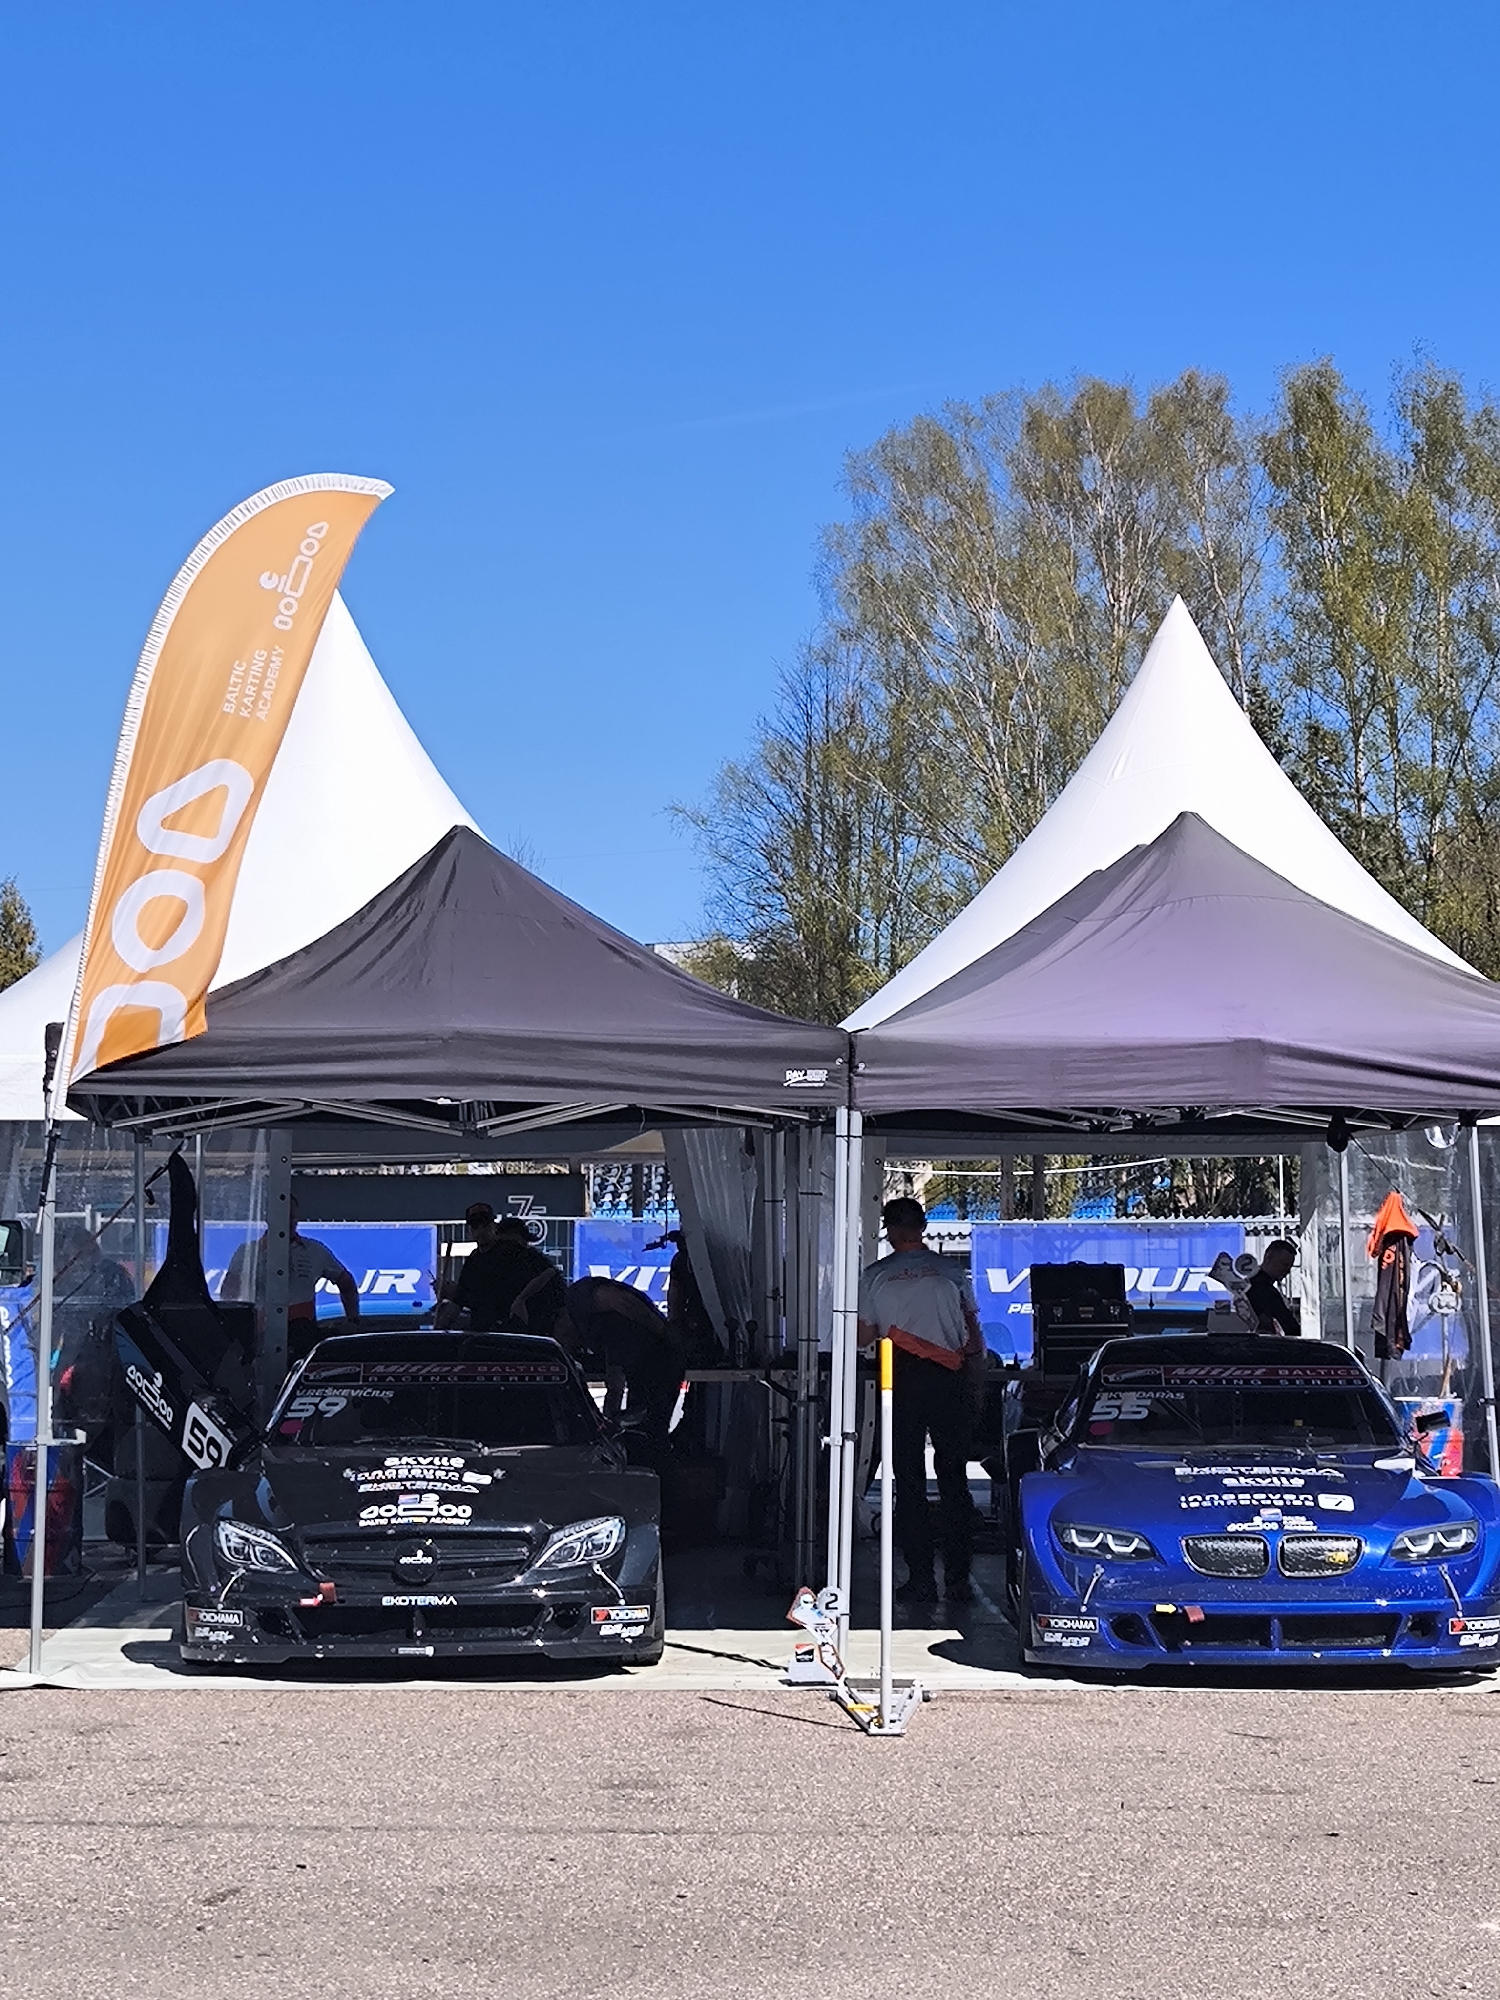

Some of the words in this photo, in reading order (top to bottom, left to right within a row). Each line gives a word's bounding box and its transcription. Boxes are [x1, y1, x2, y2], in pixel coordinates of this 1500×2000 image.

[223, 660, 247, 714] BALTIC
[239, 649, 268, 718] KARTING
[256, 644, 285, 722] ACADEMY
[285, 1397, 347, 1417] 59
[1089, 1400, 1152, 1420] 55
[187, 1416, 223, 1467] 59
[382, 1595, 457, 1606] EKOTERMA
[825, 1593, 838, 1610] 2
[1048, 1619, 1096, 1630] YOKOHAMA
